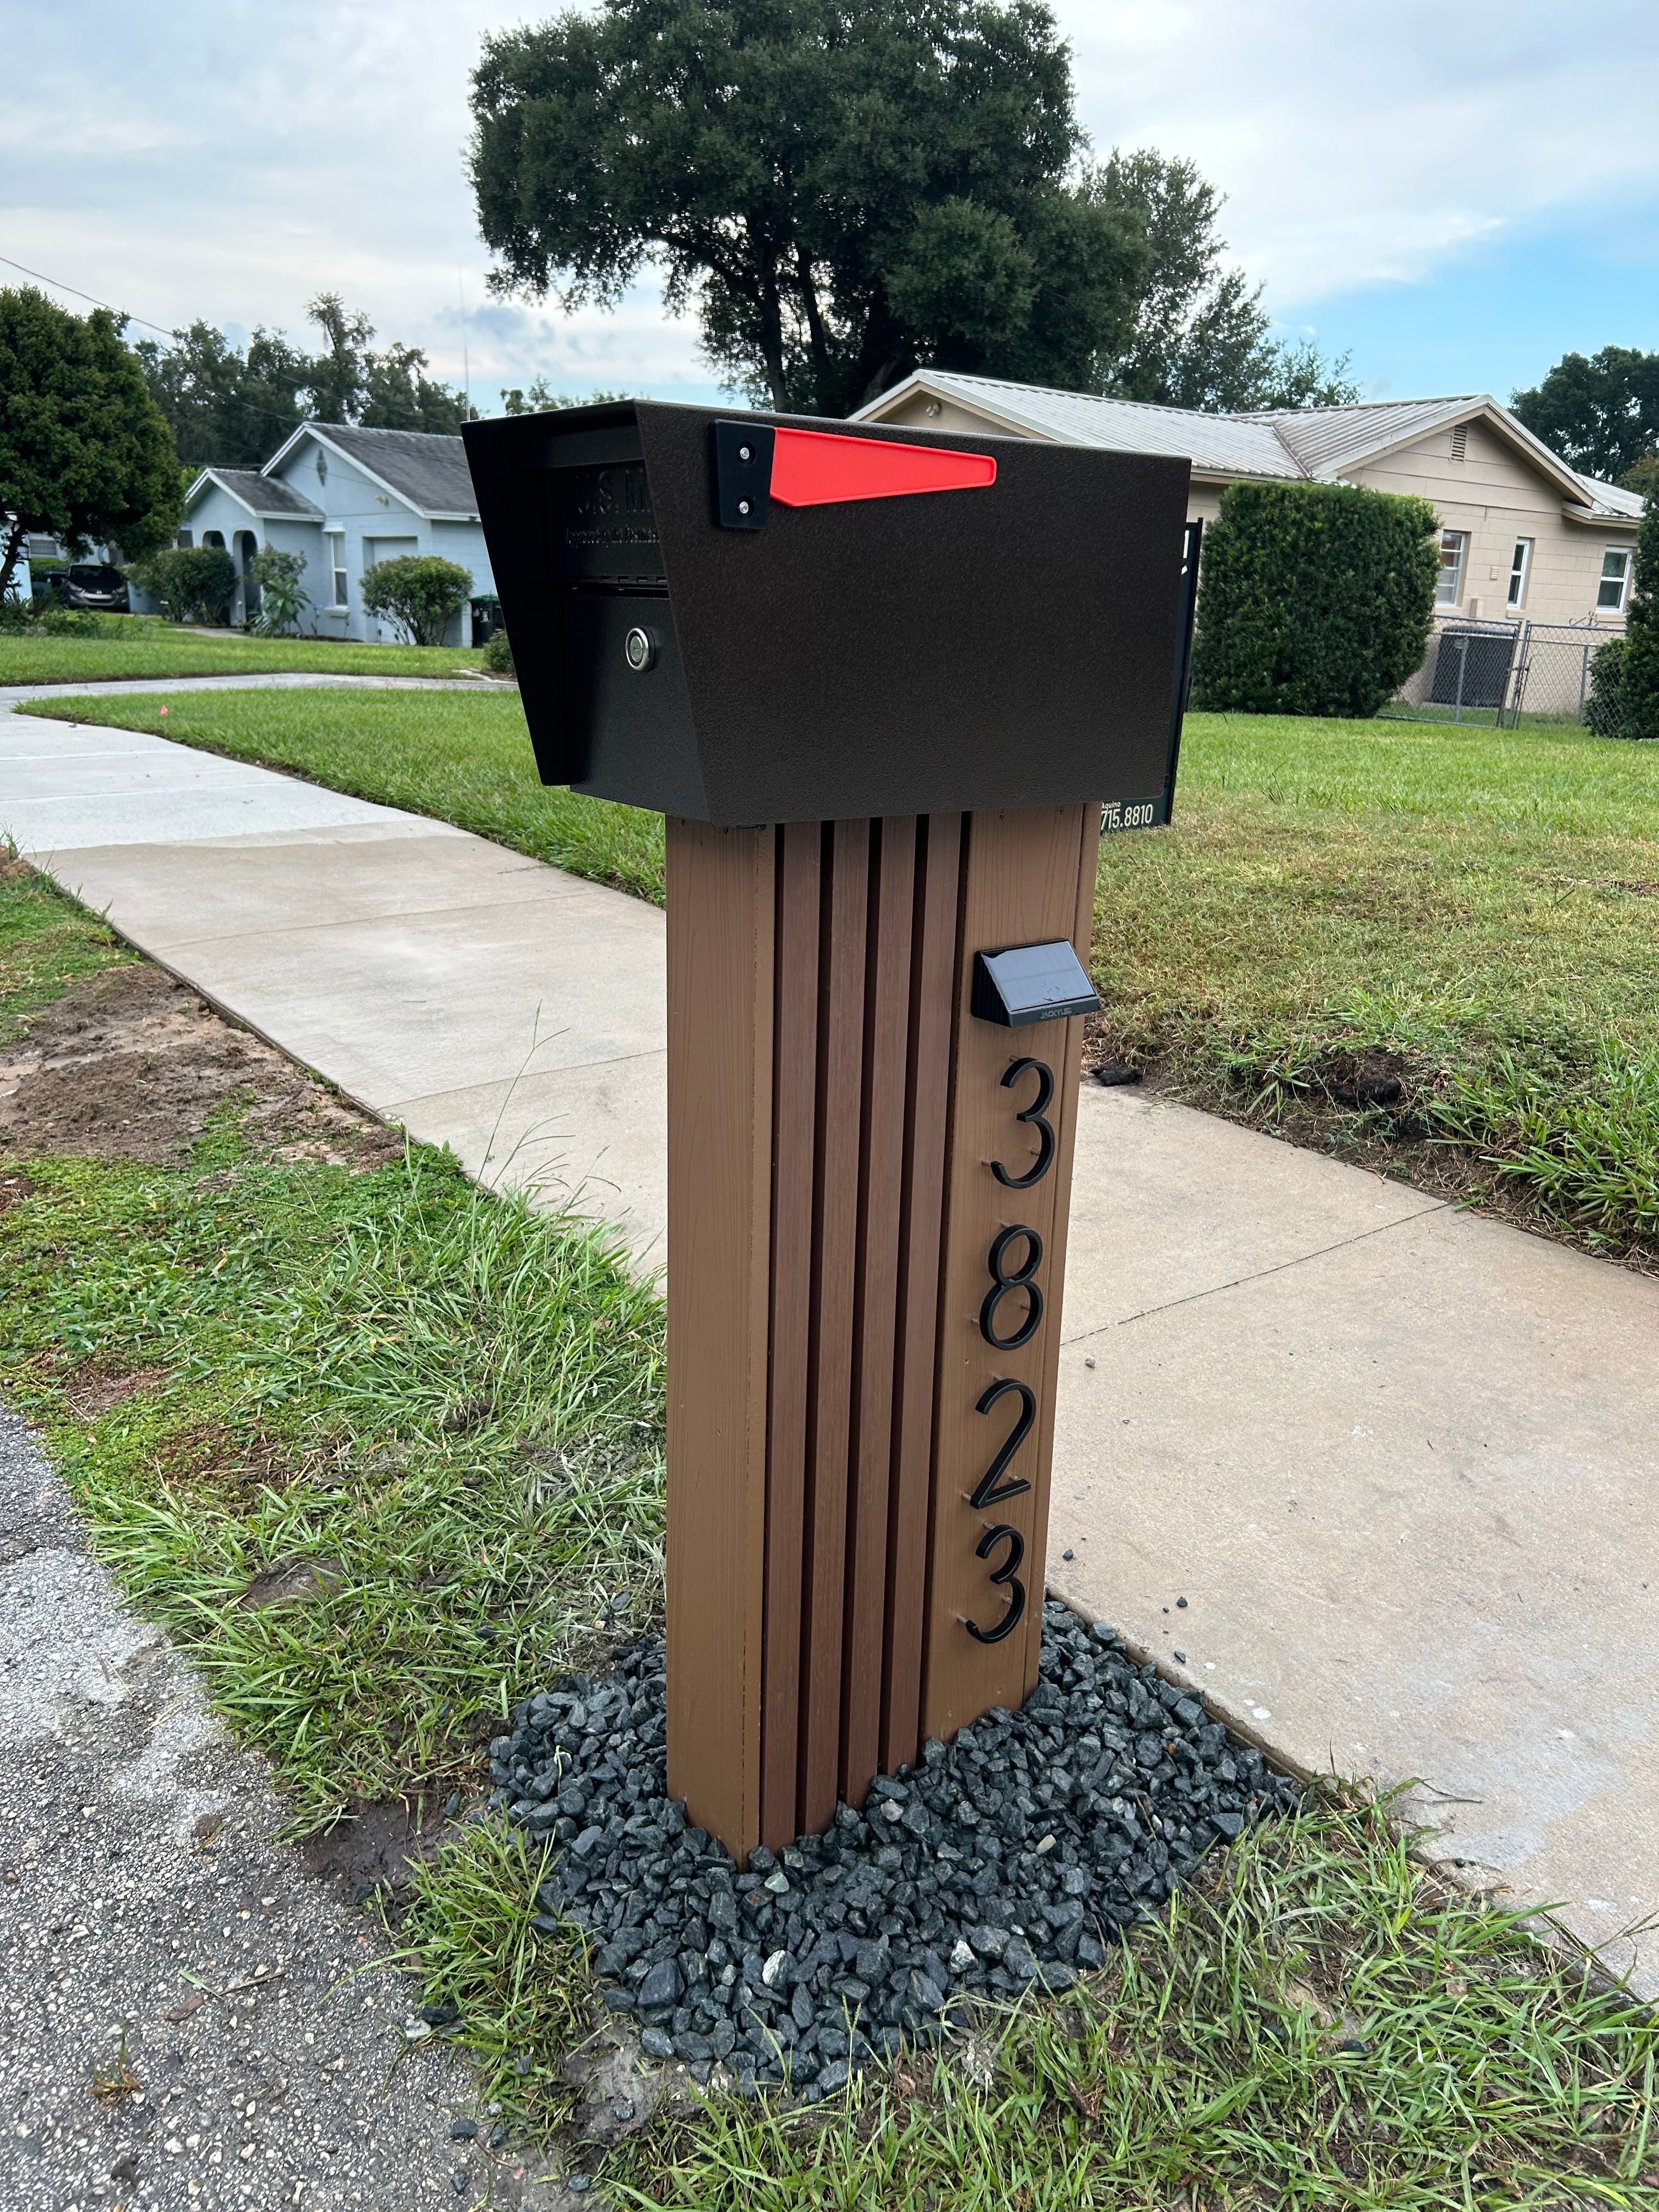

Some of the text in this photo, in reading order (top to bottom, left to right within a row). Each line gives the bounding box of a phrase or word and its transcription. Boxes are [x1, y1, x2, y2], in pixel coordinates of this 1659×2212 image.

[1101, 804, 1153, 830] 715.8810
[1102, 800, 1121, 809] Aquino
[964, 1057, 1054, 1644] 3823
